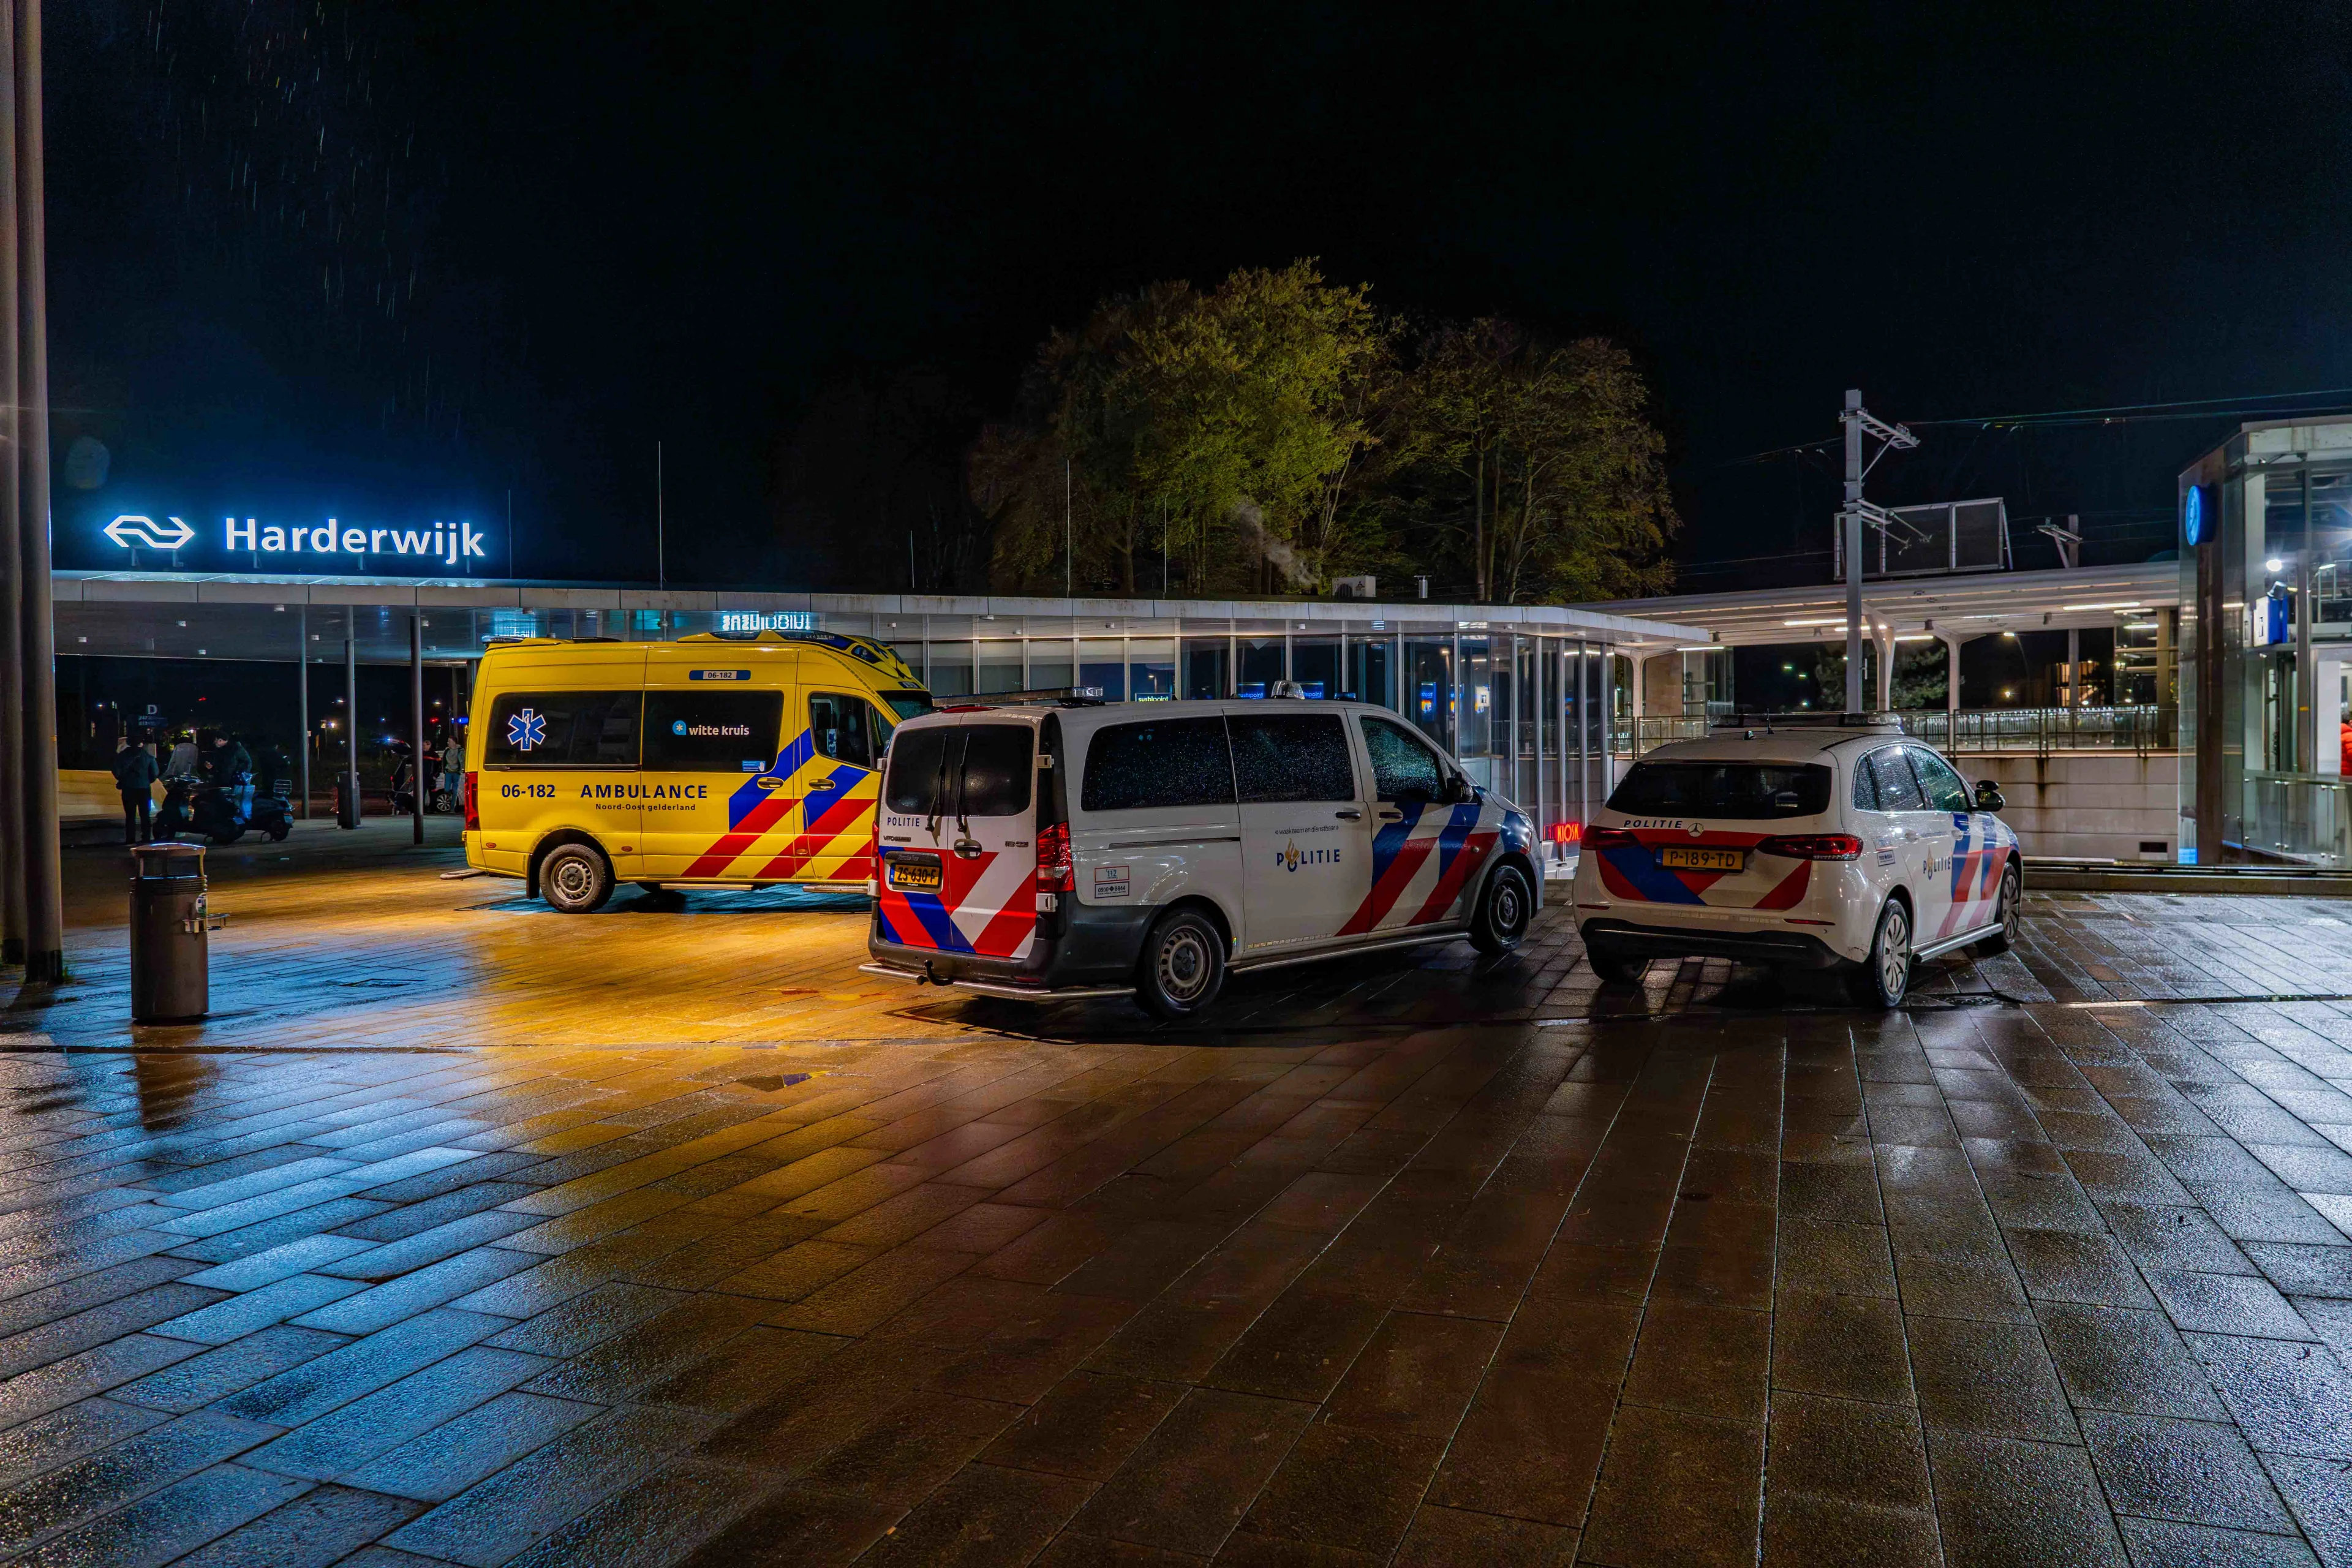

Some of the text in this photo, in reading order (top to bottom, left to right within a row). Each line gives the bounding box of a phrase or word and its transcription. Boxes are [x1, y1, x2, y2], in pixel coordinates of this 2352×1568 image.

[226, 518, 485, 564] Harderwijk
[689, 725, 750, 735] witte kruis
[501, 784, 708, 799] 06-182 AMBULANCE
[887, 816, 920, 827] POLITIE
[1624, 820, 1683, 829] POLITIE
[1557, 823, 1580, 842] KIOSK
[1276, 849, 1341, 872] POLITIE
[1670, 850, 1735, 867] P-189-TD
[897, 866, 937, 883] ZS-630-F
